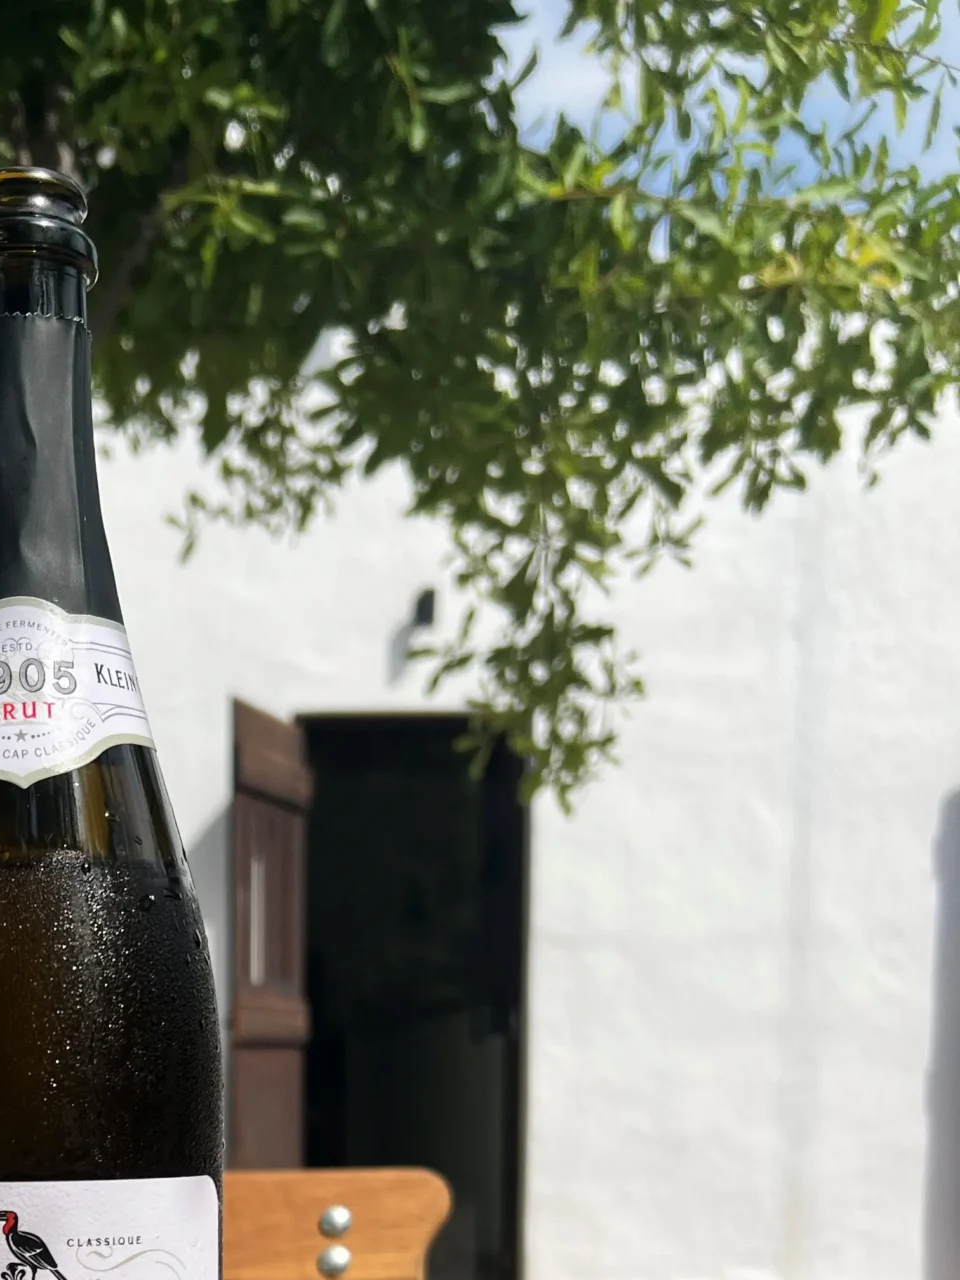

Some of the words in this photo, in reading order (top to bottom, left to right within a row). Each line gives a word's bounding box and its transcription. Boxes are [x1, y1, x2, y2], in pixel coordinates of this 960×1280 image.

[6, 619, 68, 647] FERMENTED
[2, 748, 29, 760] CAP
[66, 1235, 142, 1248] CLASSIQUE
